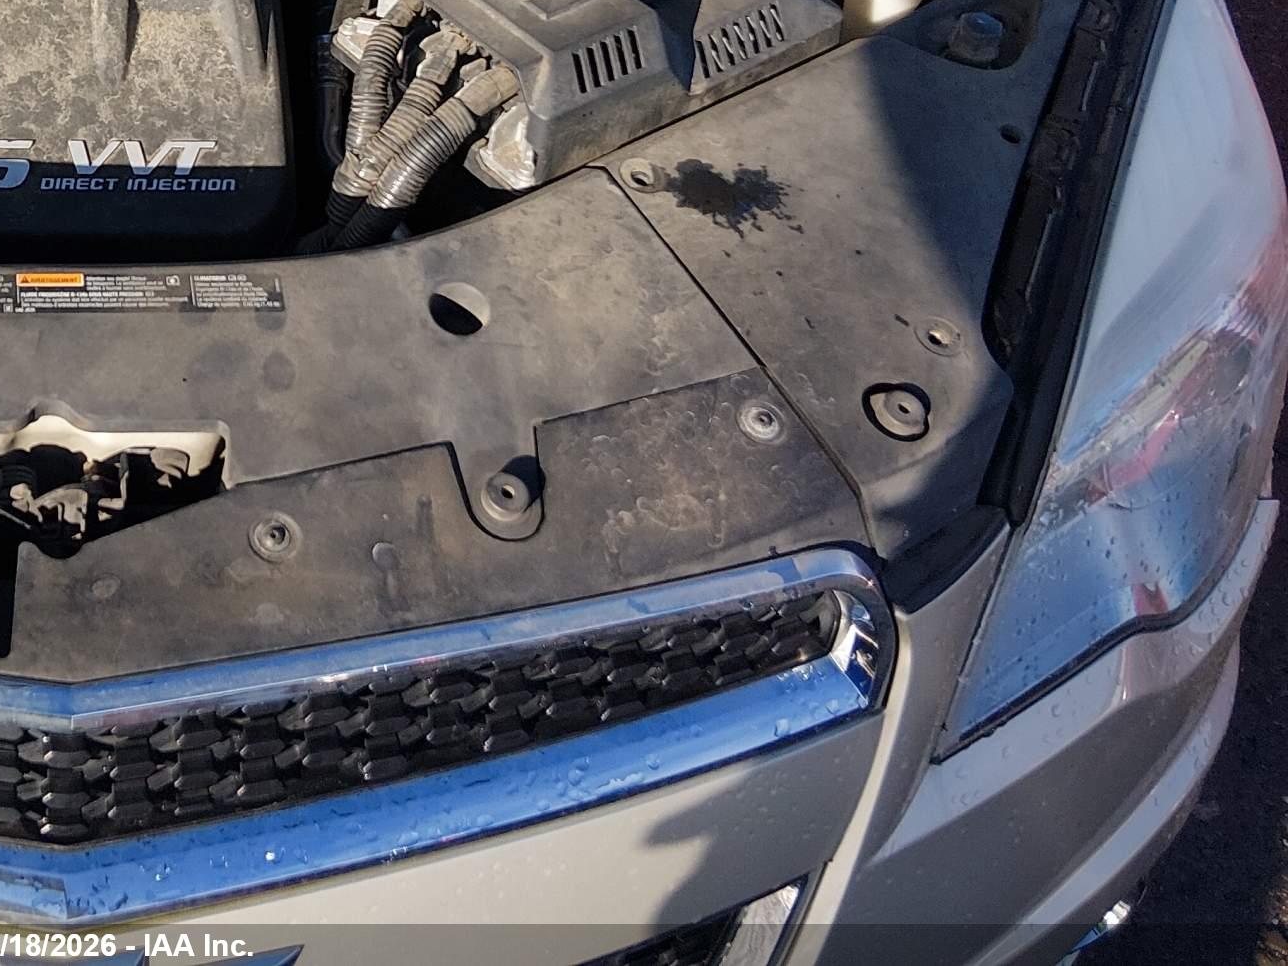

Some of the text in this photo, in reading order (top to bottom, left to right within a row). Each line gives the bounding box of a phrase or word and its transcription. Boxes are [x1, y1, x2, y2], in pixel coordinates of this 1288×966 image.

[68, 138, 219, 176] VVT
[40, 177, 237, 192] DIRECT INJECTION
